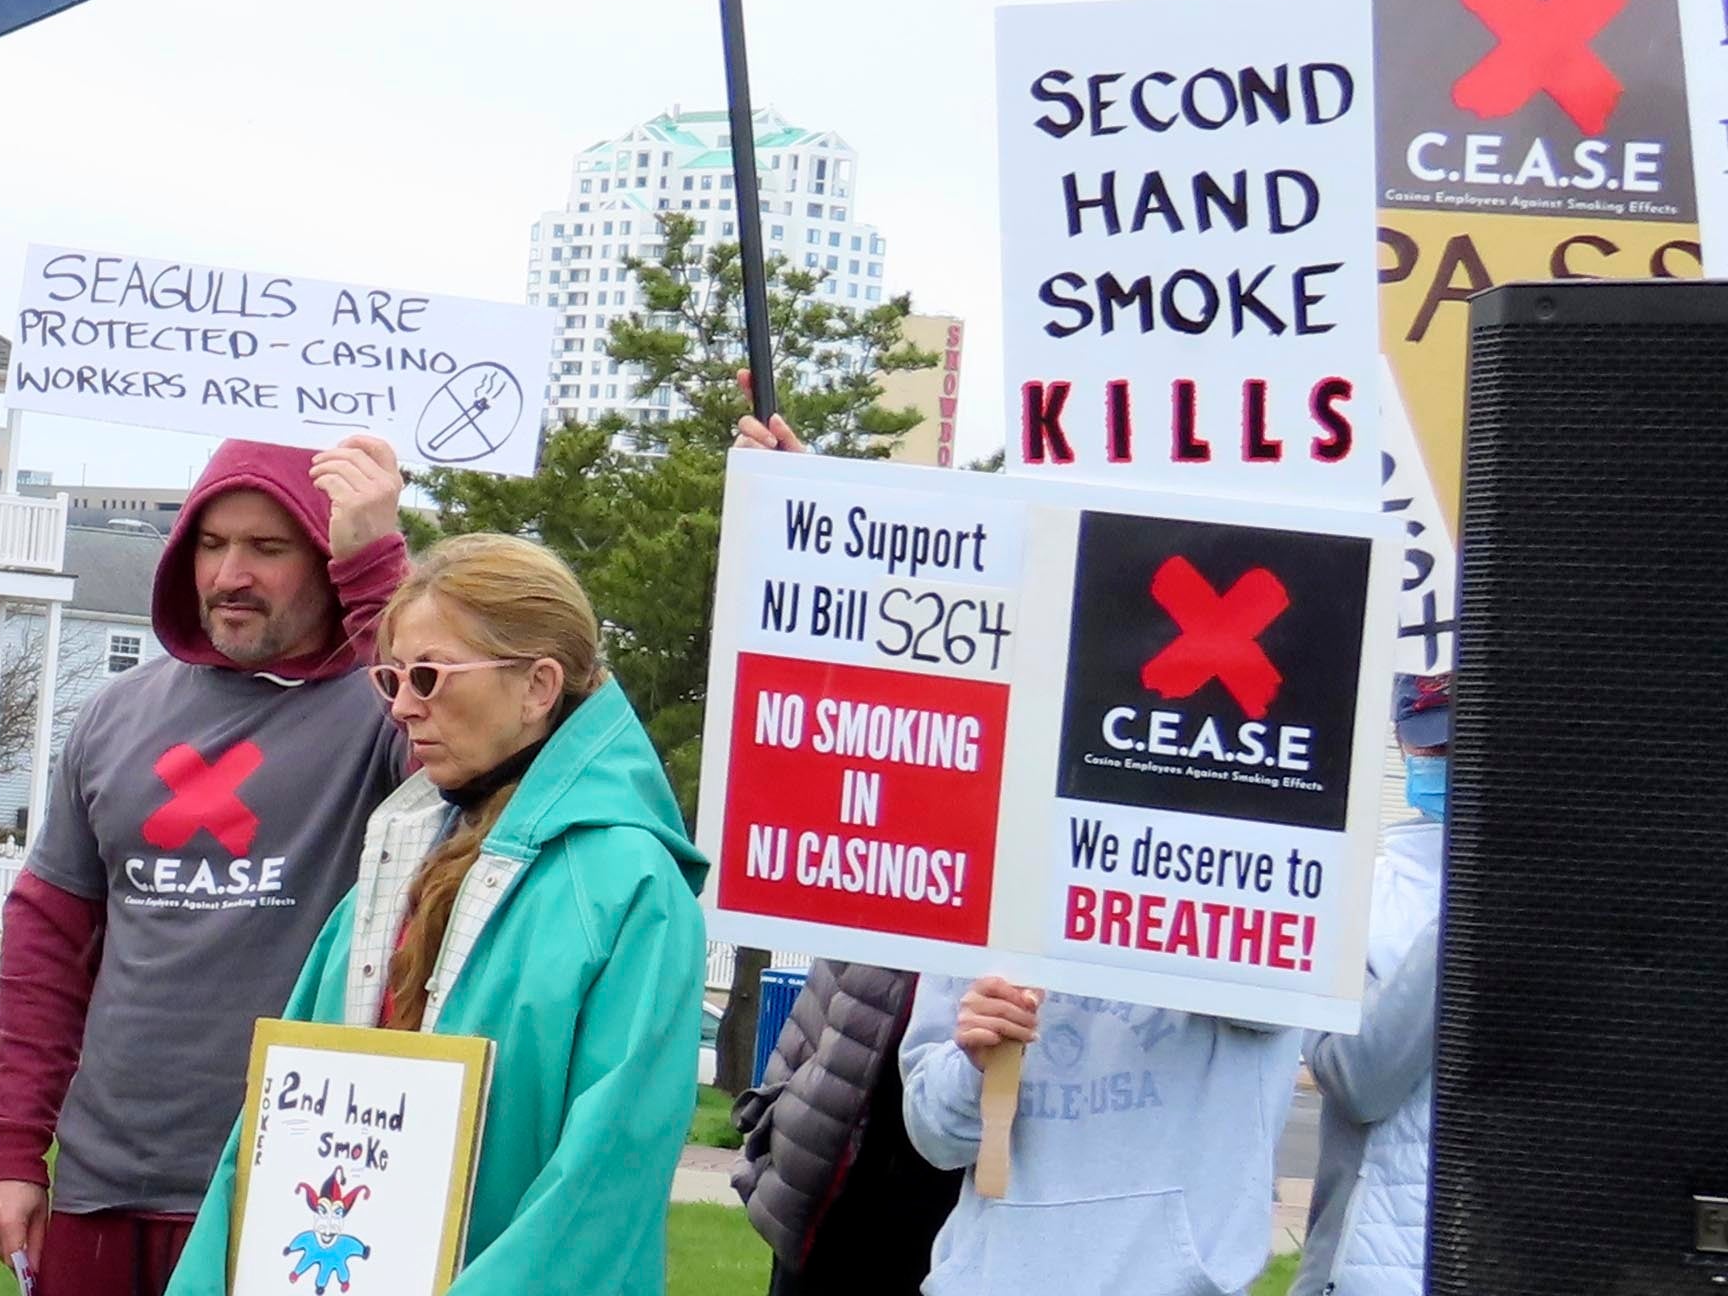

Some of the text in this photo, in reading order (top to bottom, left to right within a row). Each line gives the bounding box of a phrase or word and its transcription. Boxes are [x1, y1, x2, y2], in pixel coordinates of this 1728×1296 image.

[1029, 61, 1355, 139] SECOND
[1406, 131, 1662, 192] C.E.A.S.E
[1061, 167, 1321, 238] HAND
[1385, 188, 1679, 216] Casino Employees Against Smoking Effects
[42, 254, 431, 334] SEAGULLS ARE
[1038, 261, 1347, 339] SMOKE
[16, 362, 398, 422] WORKERS ARE NOT!
[301, 339, 458, 375] CASINO
[1020, 375, 1354, 466] KILLS
[782, 499, 987, 577] We Support
[761, 580, 1012, 671] NJ Bill S264
[755, 690, 980, 774] NO SMOKING
[1101, 706, 1313, 772] C.E.A.S.E
[839, 769, 881, 827] IN
[1083, 753, 1324, 792] Casino Employees Against Smoking Effects
[124, 856, 287, 895] C.E.A.S.E
[746, 823, 967, 908] NJ CASINOS!
[1069, 817, 1325, 899] We deserve to
[1062, 884, 1318, 973] BREATHE!
[278, 1071, 406, 1132] 2nd hand
